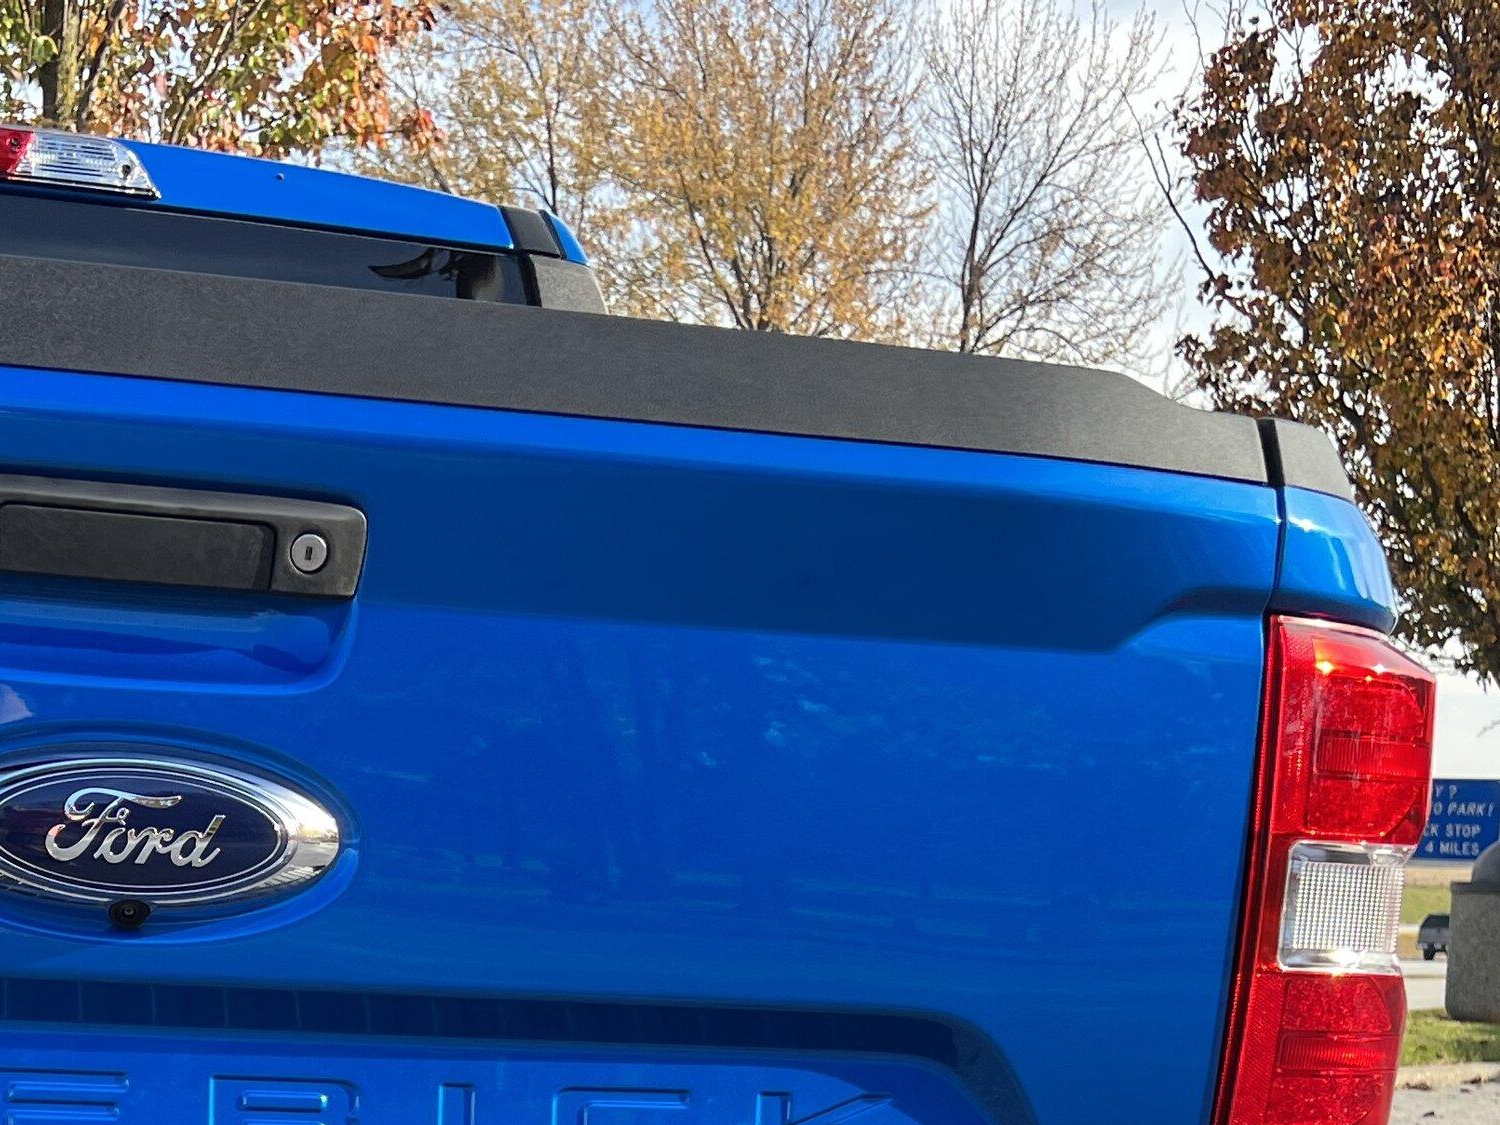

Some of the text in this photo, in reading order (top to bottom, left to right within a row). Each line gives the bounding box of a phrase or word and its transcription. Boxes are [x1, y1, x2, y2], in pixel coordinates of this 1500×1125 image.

[45, 786, 227, 868] Ford
[1445, 822, 1481, 838] STOP
[1439, 840, 1480, 856] MILES
